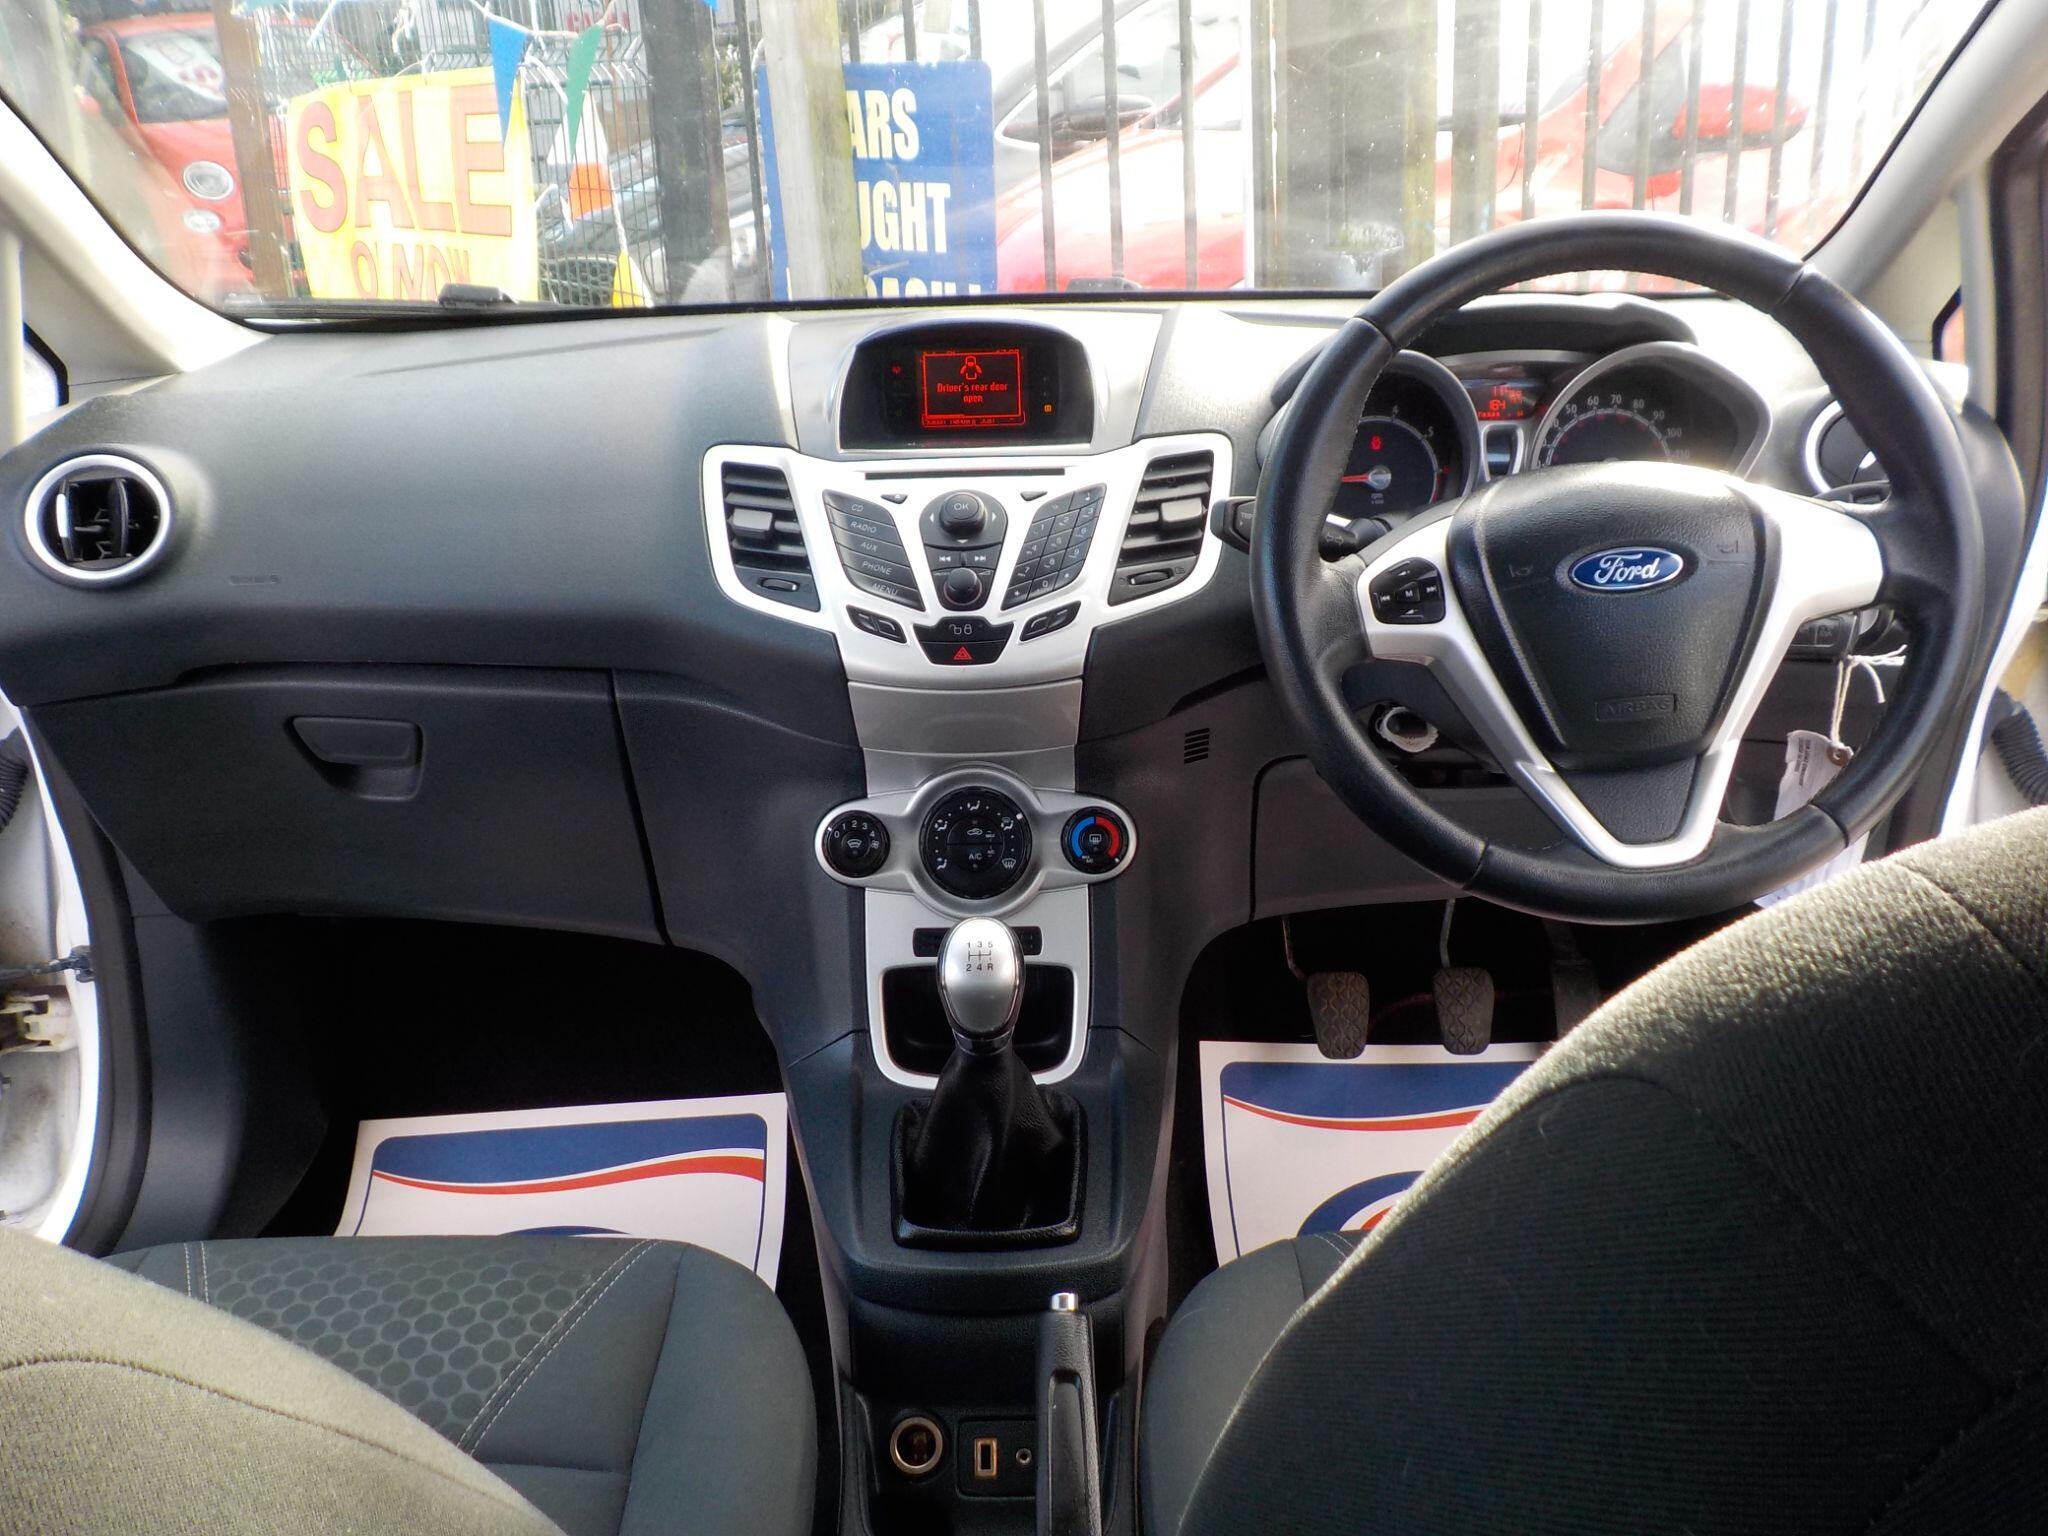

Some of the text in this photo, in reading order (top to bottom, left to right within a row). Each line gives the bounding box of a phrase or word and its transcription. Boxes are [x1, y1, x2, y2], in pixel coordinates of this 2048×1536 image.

[846, 87, 920, 161] ARS
[299, 83, 512, 237] SALE
[858, 179, 951, 253] UGHT
[936, 381, 1008, 393] Driver's rear door
[963, 395, 983, 403] open
[1587, 395, 1600, 406] 60
[1610, 394, 1622, 404] 70
[1632, 398, 1645, 409] 80
[1565, 403, 1577, 414] 50
[1652, 410, 1665, 421] 90
[851, 503, 864, 513] CD
[953, 502, 969, 511] OK
[850, 521, 877, 533] RADIO
[860, 541, 878, 552] AUX
[862, 560, 893, 575] PHONE
[1594, 553, 1661, 584] Ford
[873, 583, 898, 596] MENU
[1405, 589, 1414, 598] M
[834, 830, 840, 839] 0
[851, 820, 858, 828] 2
[862, 822, 868, 830] 3
[966, 963, 994, 972] 2 4 R
